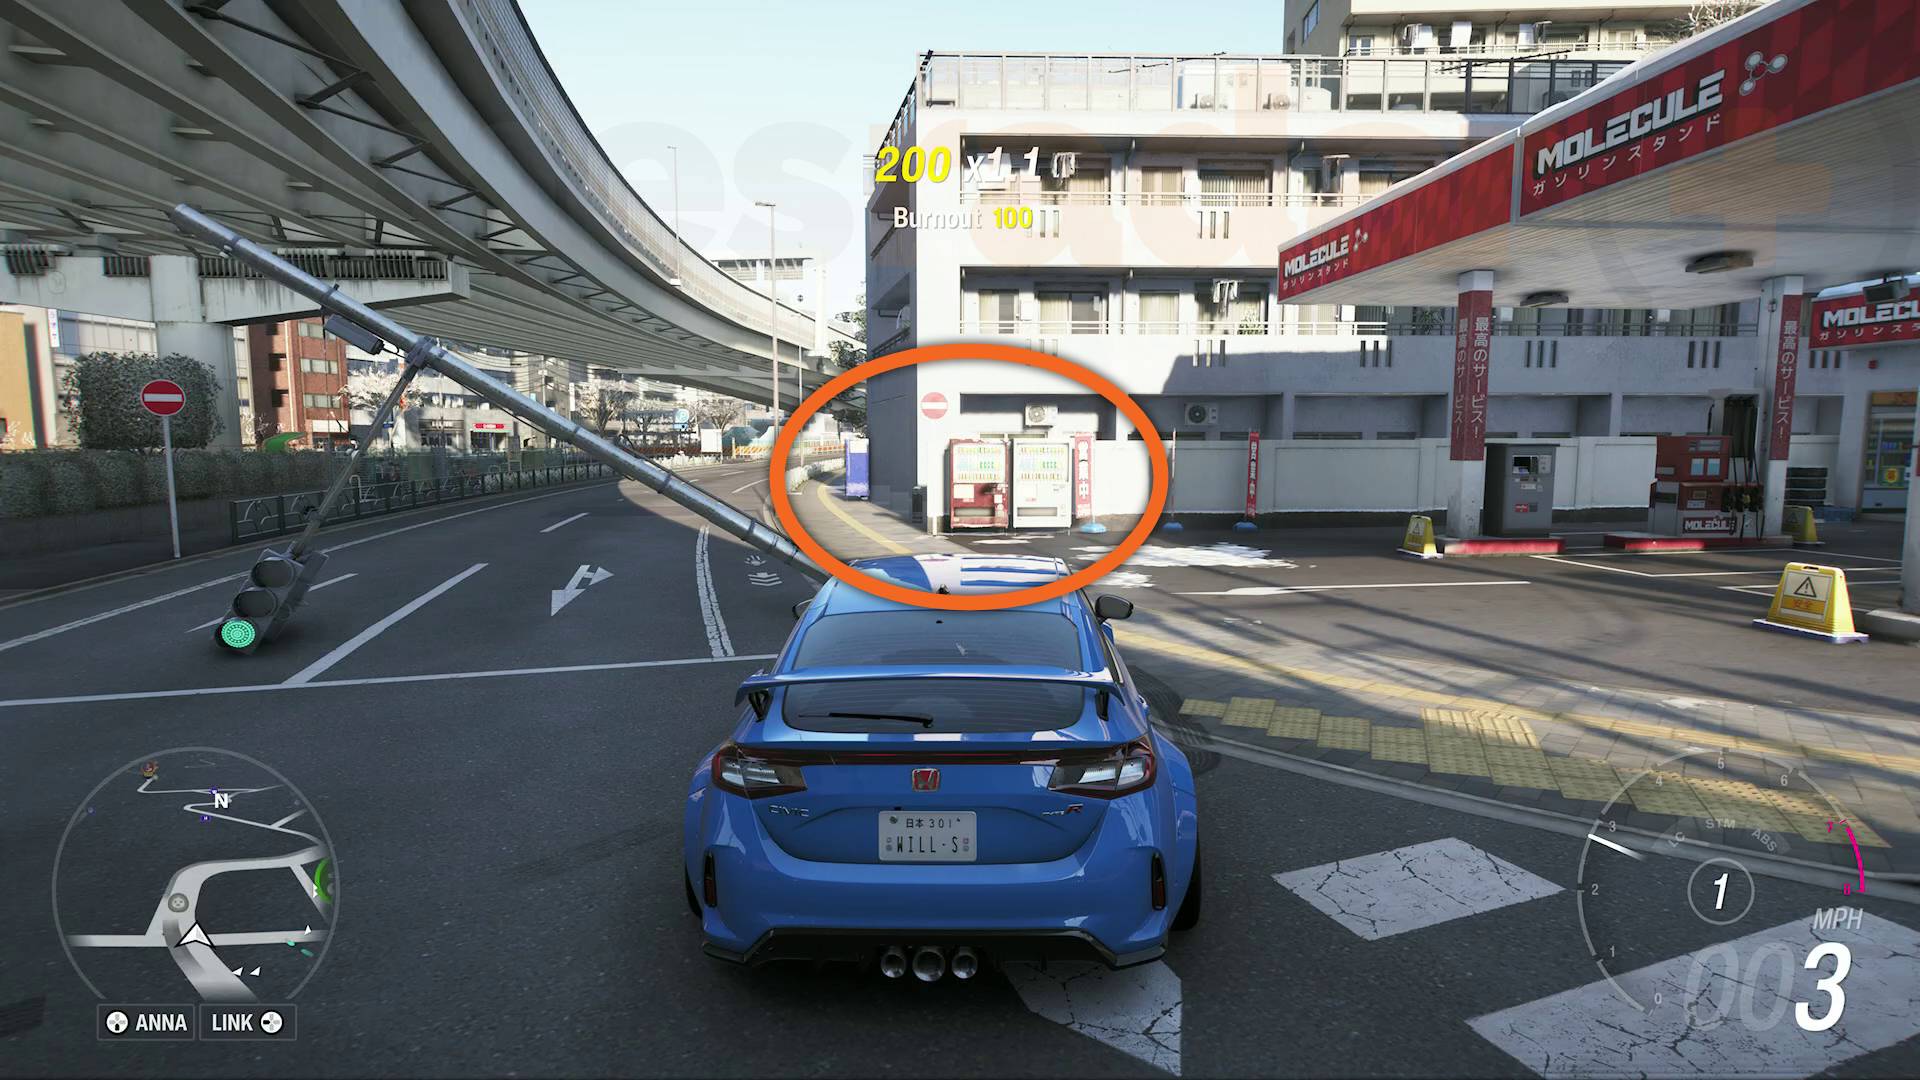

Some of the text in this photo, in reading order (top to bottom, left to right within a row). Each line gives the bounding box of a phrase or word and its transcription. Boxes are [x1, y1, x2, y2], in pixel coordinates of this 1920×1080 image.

[1537, 69, 1725, 175] MOLECULE
[1532, 113, 1721, 197] ガソリンスタンド
[1284, 234, 1350, 278] MOLECULE
[905, 818, 953, 828] 日本 301
